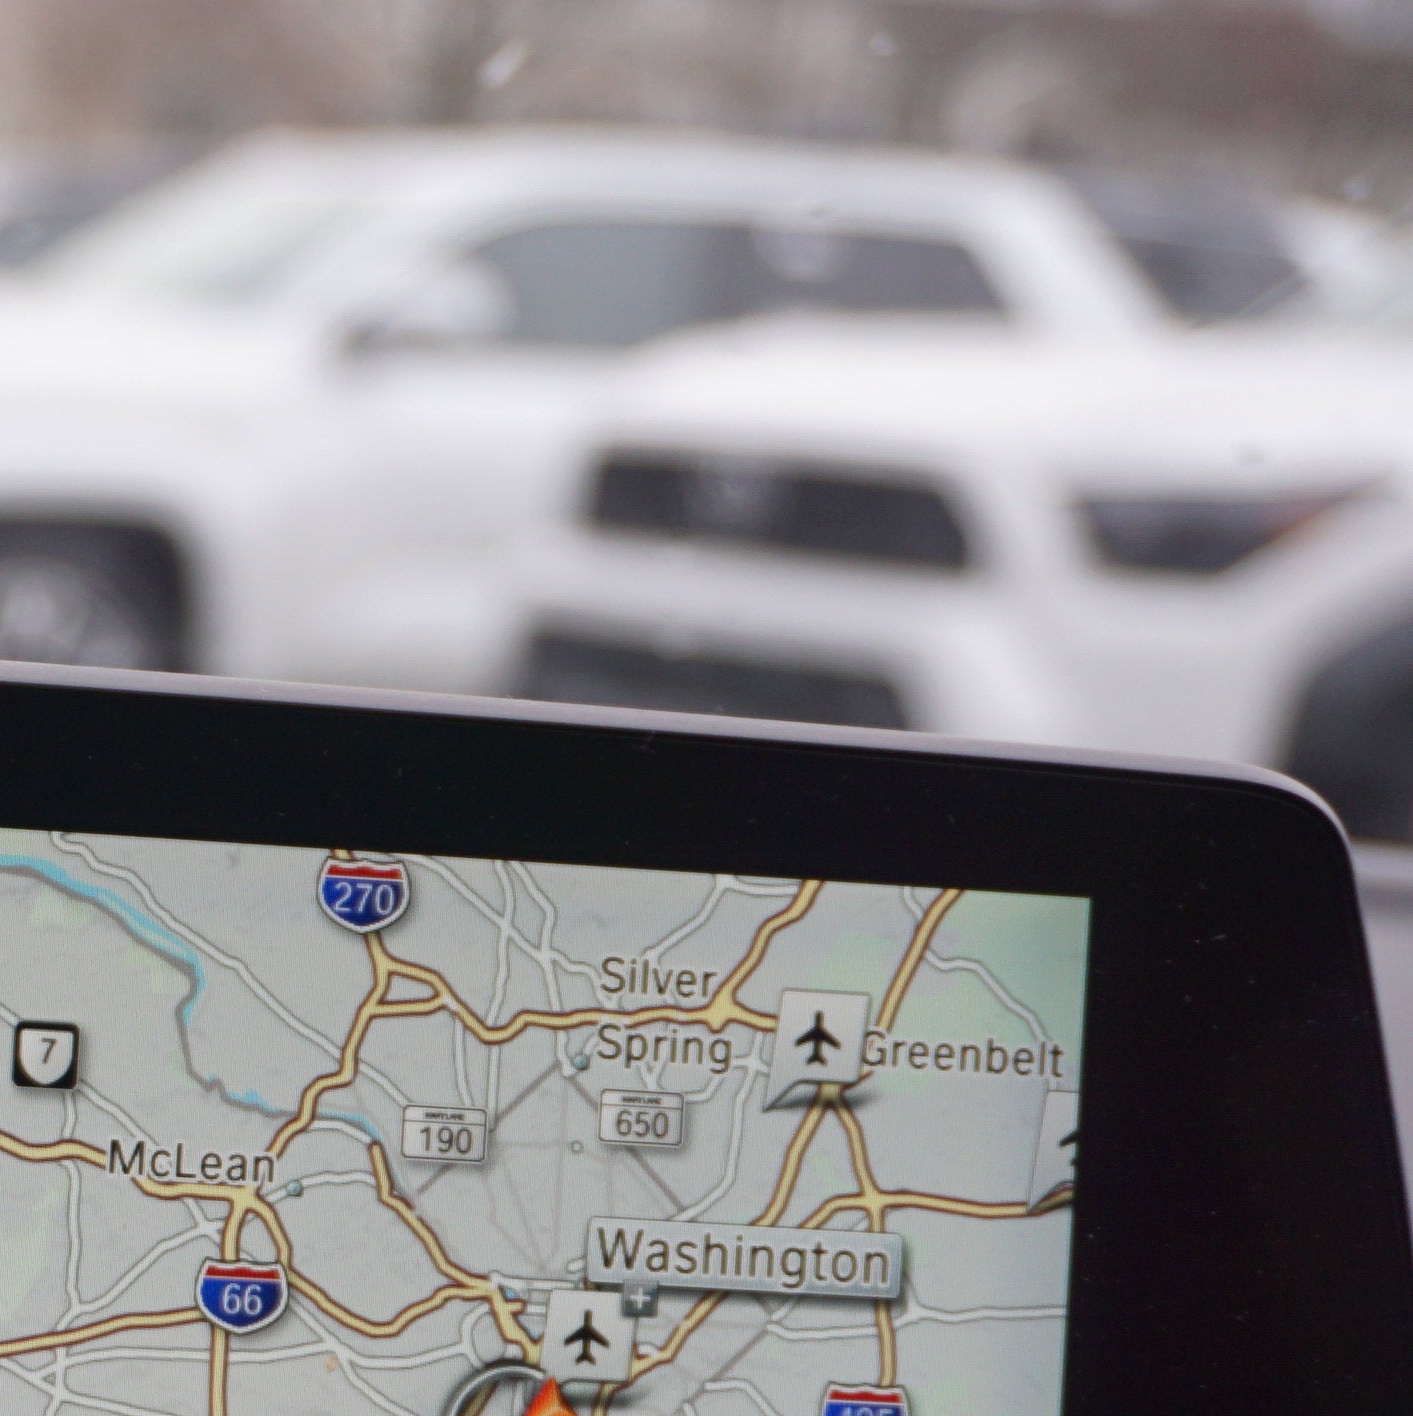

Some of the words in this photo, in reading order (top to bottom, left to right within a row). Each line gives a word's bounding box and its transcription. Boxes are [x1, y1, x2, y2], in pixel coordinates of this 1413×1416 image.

[333, 883, 395, 917] 270
[601, 957, 718, 999] Silver
[41, 1039, 56, 1064] 7
[597, 1025, 733, 1074] Spring
[862, 1032, 1064, 1078] Greenbelt
[420, 1126, 472, 1155] 190
[616, 1109, 669, 1139] 650
[108, 1140, 274, 1183] McLean
[597, 1227, 890, 1289] Washington
[222, 1284, 261, 1316] 66
